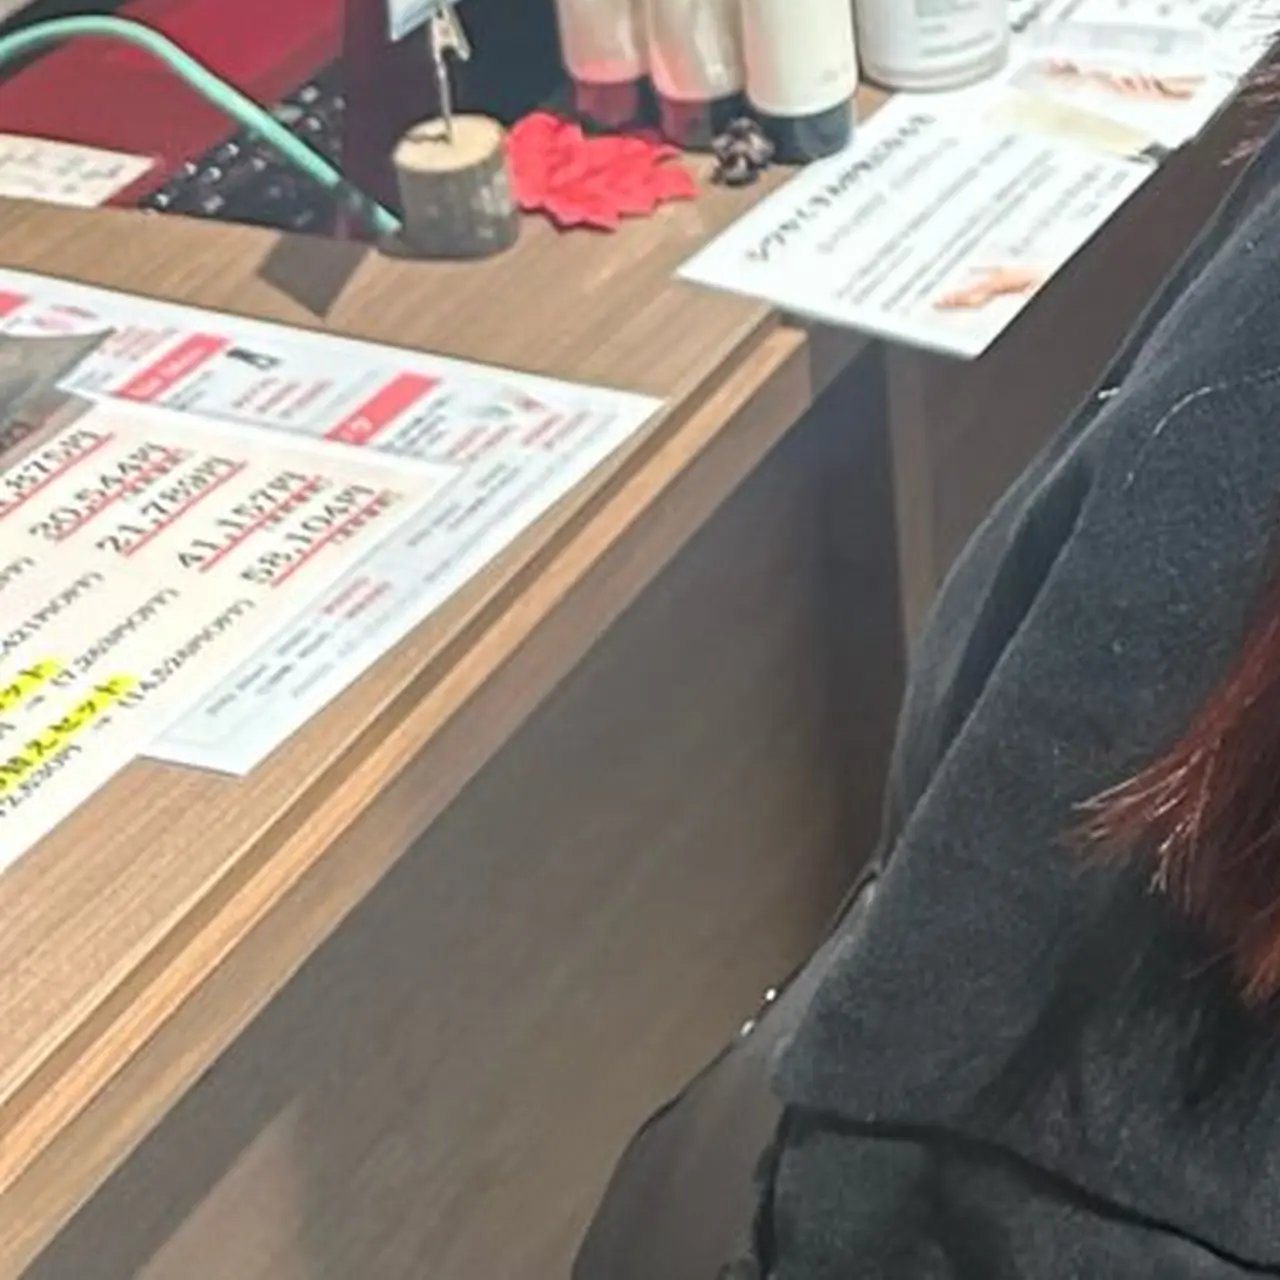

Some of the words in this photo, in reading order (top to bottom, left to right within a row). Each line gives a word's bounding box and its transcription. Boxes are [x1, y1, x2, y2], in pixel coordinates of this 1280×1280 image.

[0, 429, 101, 510] ,875円
[177, 470, 308, 569] 41,157円
[239, 484, 376, 585] 58,104円
